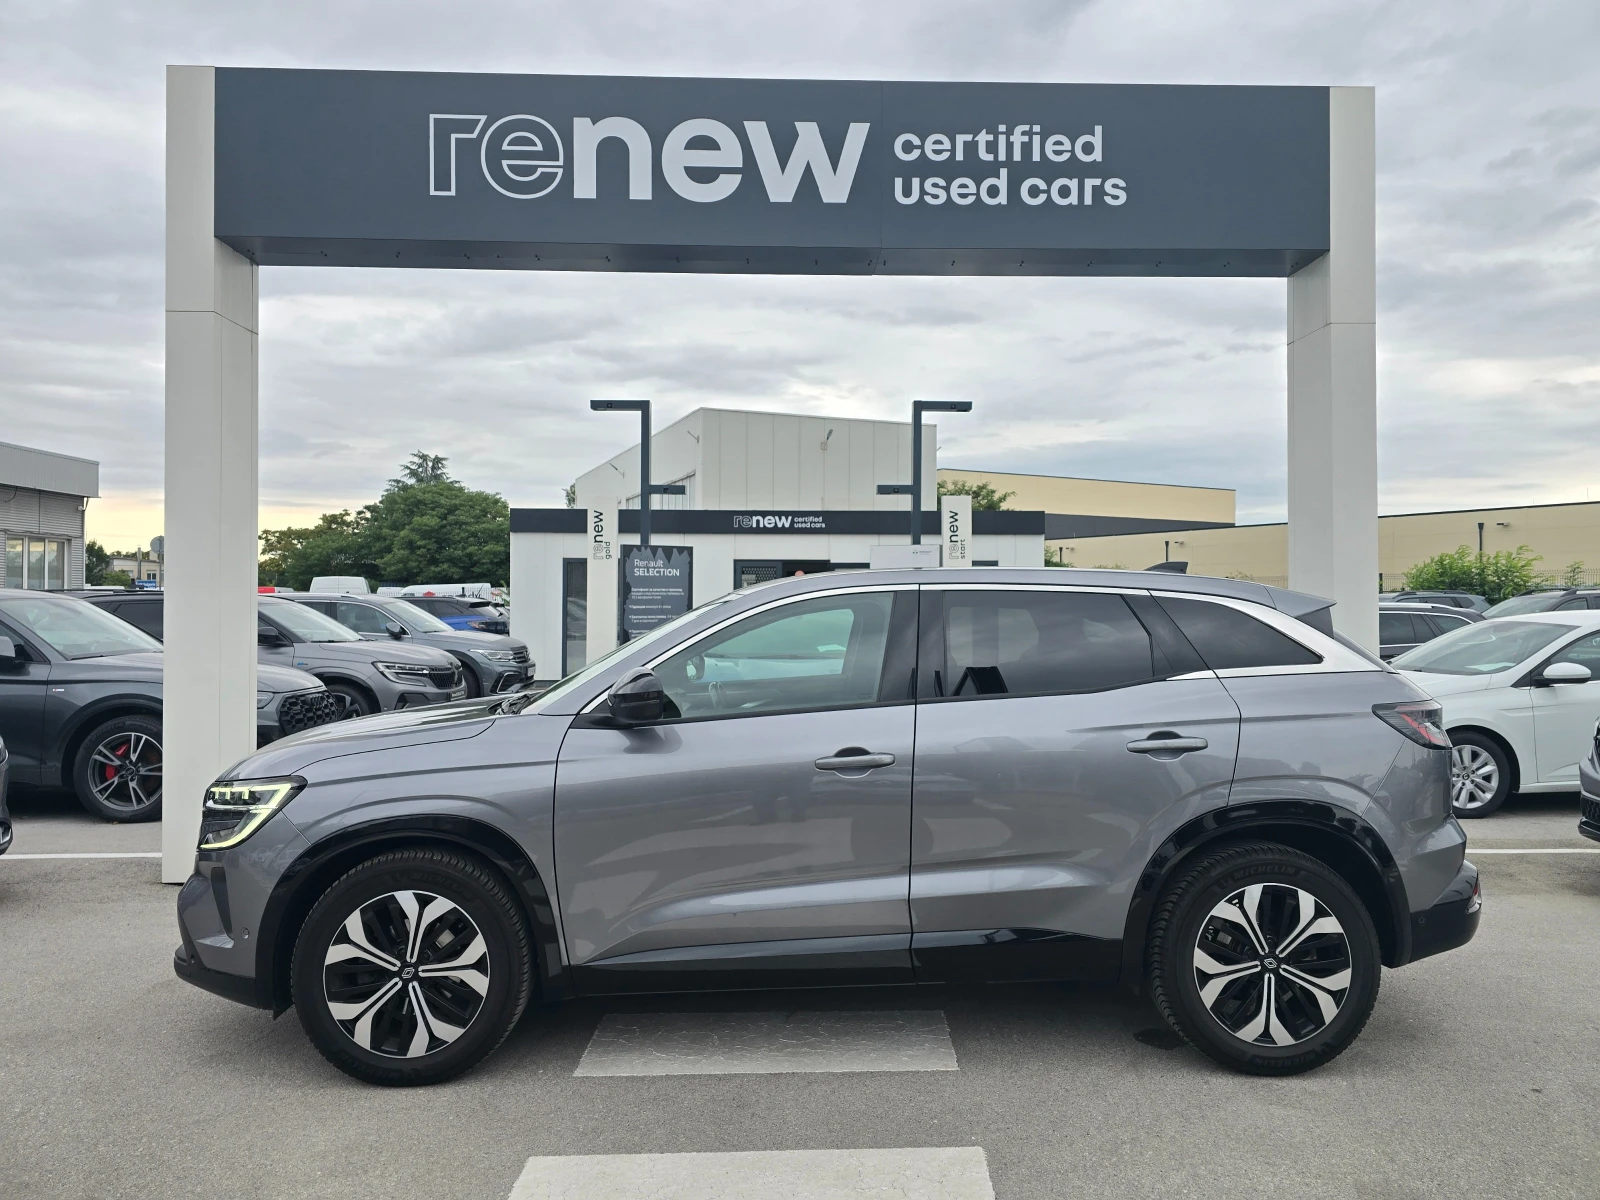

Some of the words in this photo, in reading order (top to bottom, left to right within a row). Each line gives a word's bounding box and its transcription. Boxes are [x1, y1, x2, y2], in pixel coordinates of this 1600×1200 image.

[429, 113, 871, 203] renew
[893, 124, 1103, 163] certified
[894, 167, 1008, 205] used
[1020, 177, 1127, 206] cars
[593, 510, 604, 560] renew
[733, 515, 792, 528] renew
[949, 510, 959, 560] renew
[604, 541, 612, 560] gold
[634, 559, 664, 568] Renault
[634, 568, 680, 577] SELECTION
[1233, 865, 1296, 880] MICHELIN
